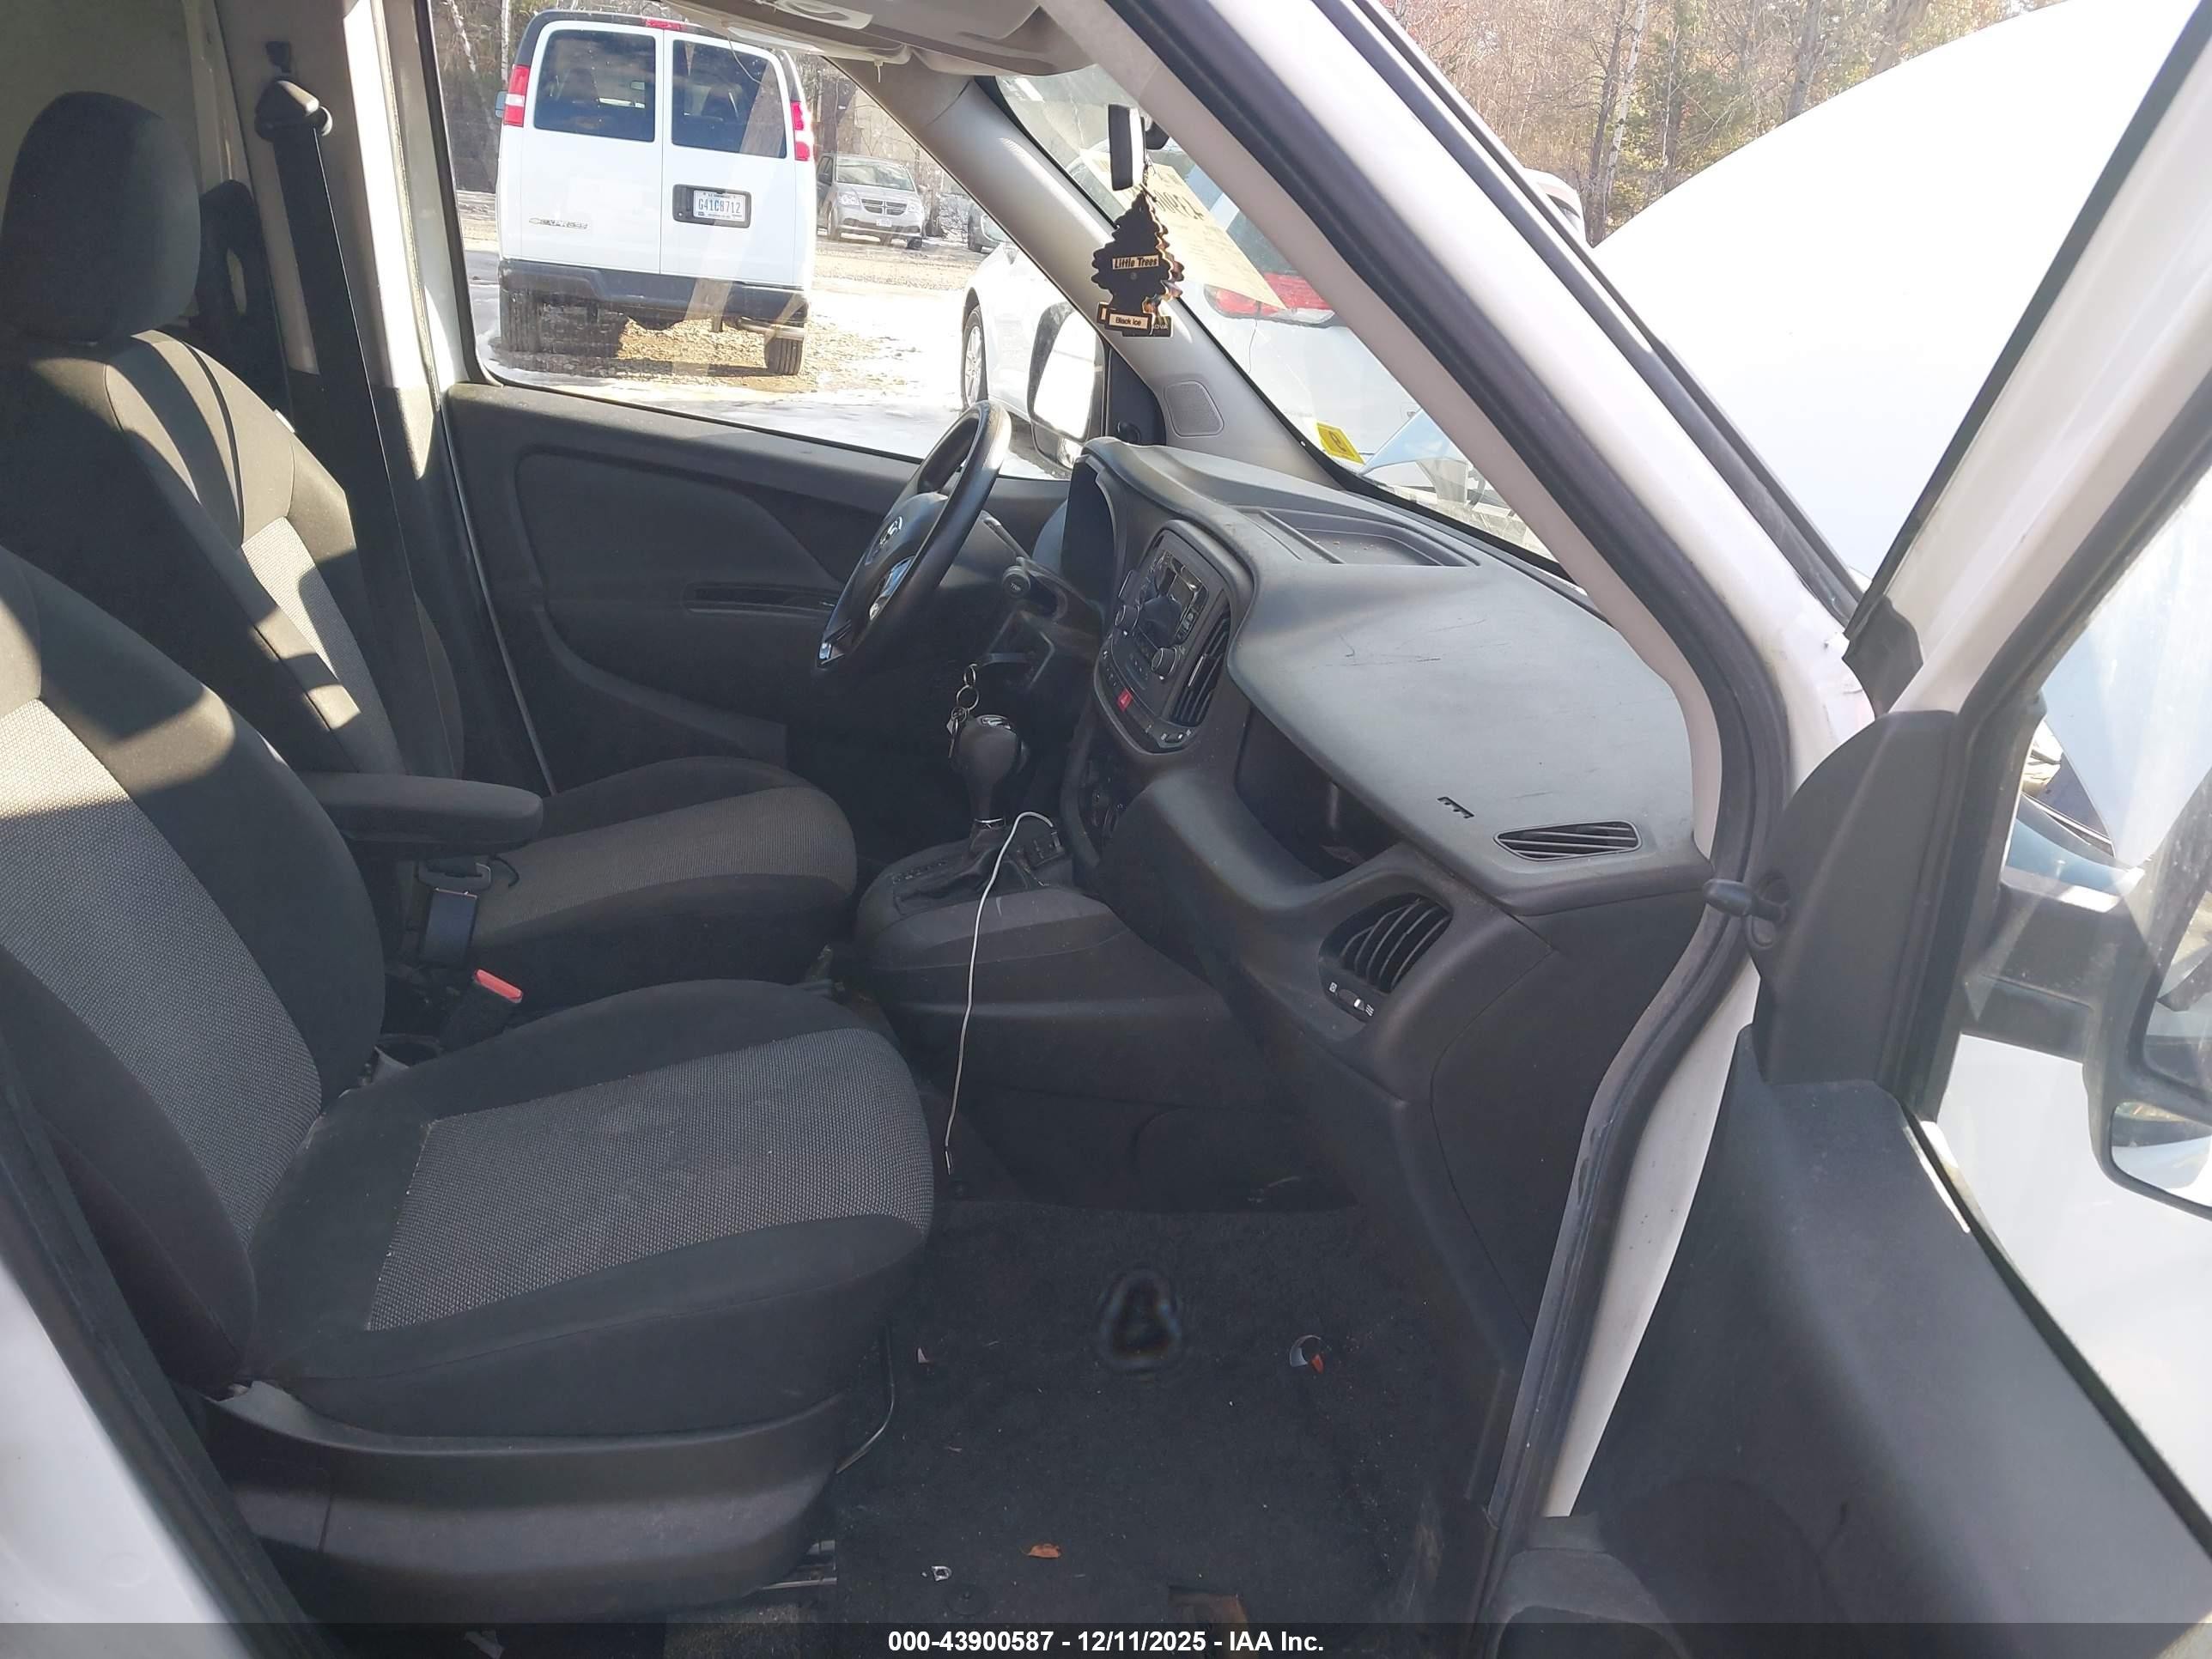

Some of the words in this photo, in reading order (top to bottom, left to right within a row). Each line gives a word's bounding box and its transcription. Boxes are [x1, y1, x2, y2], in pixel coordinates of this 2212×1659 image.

[1114, 258, 1135, 269] Little
[1137, 257, 1158, 267] Trees
[1115, 315, 1132, 325] Black
